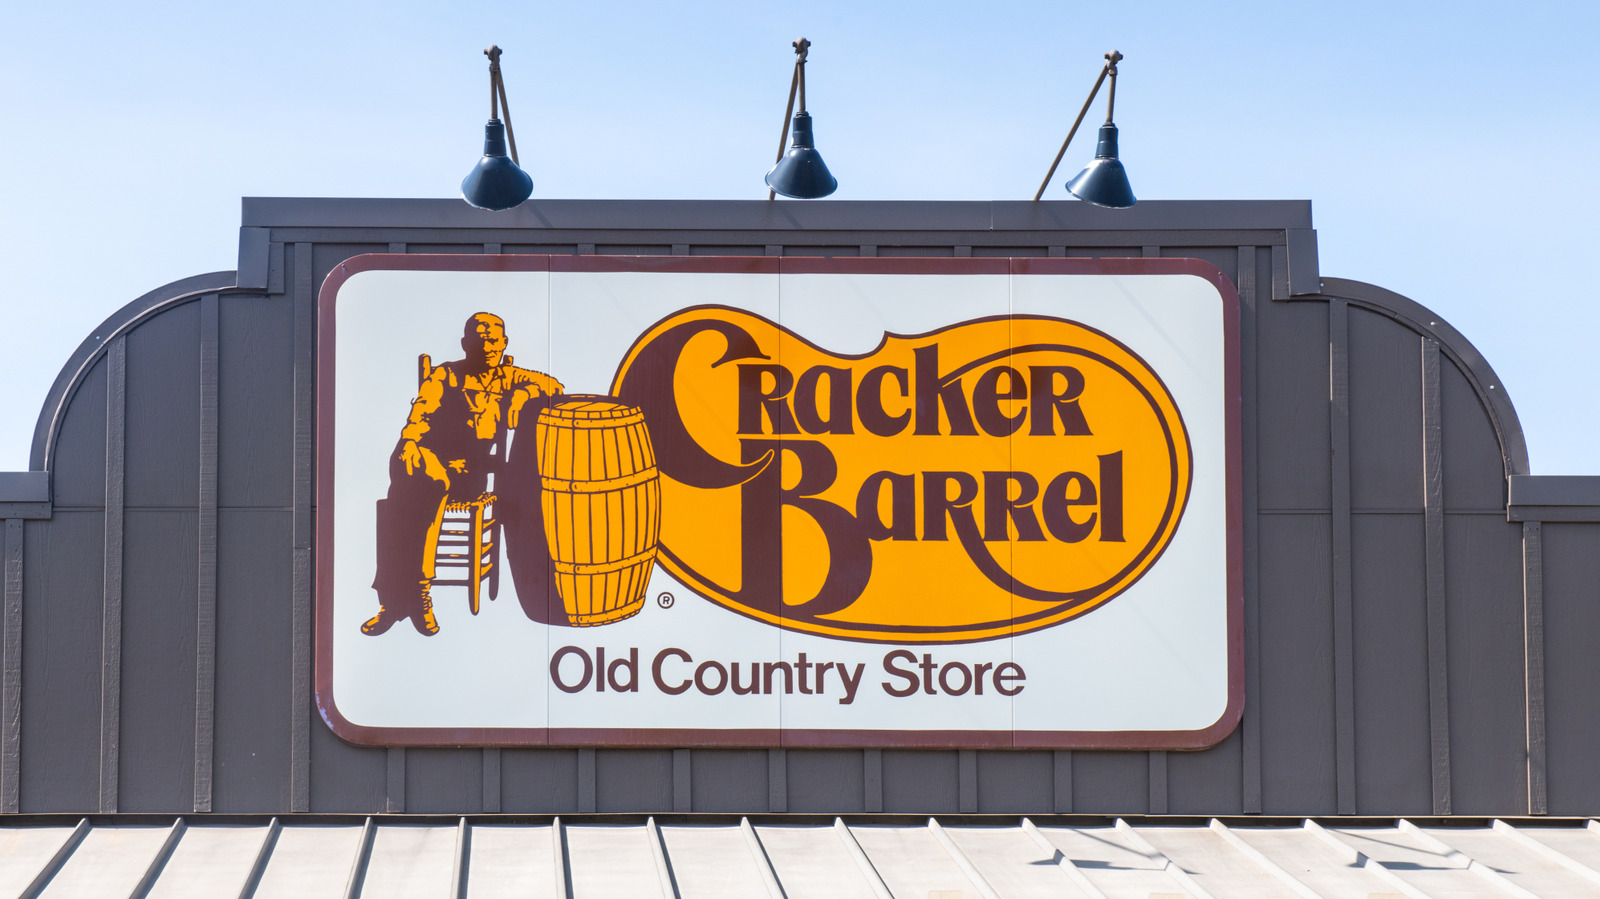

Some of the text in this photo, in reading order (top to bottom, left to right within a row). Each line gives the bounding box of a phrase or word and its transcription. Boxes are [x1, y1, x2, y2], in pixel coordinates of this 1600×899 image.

[550, 645, 1026, 705] Old Country Store
